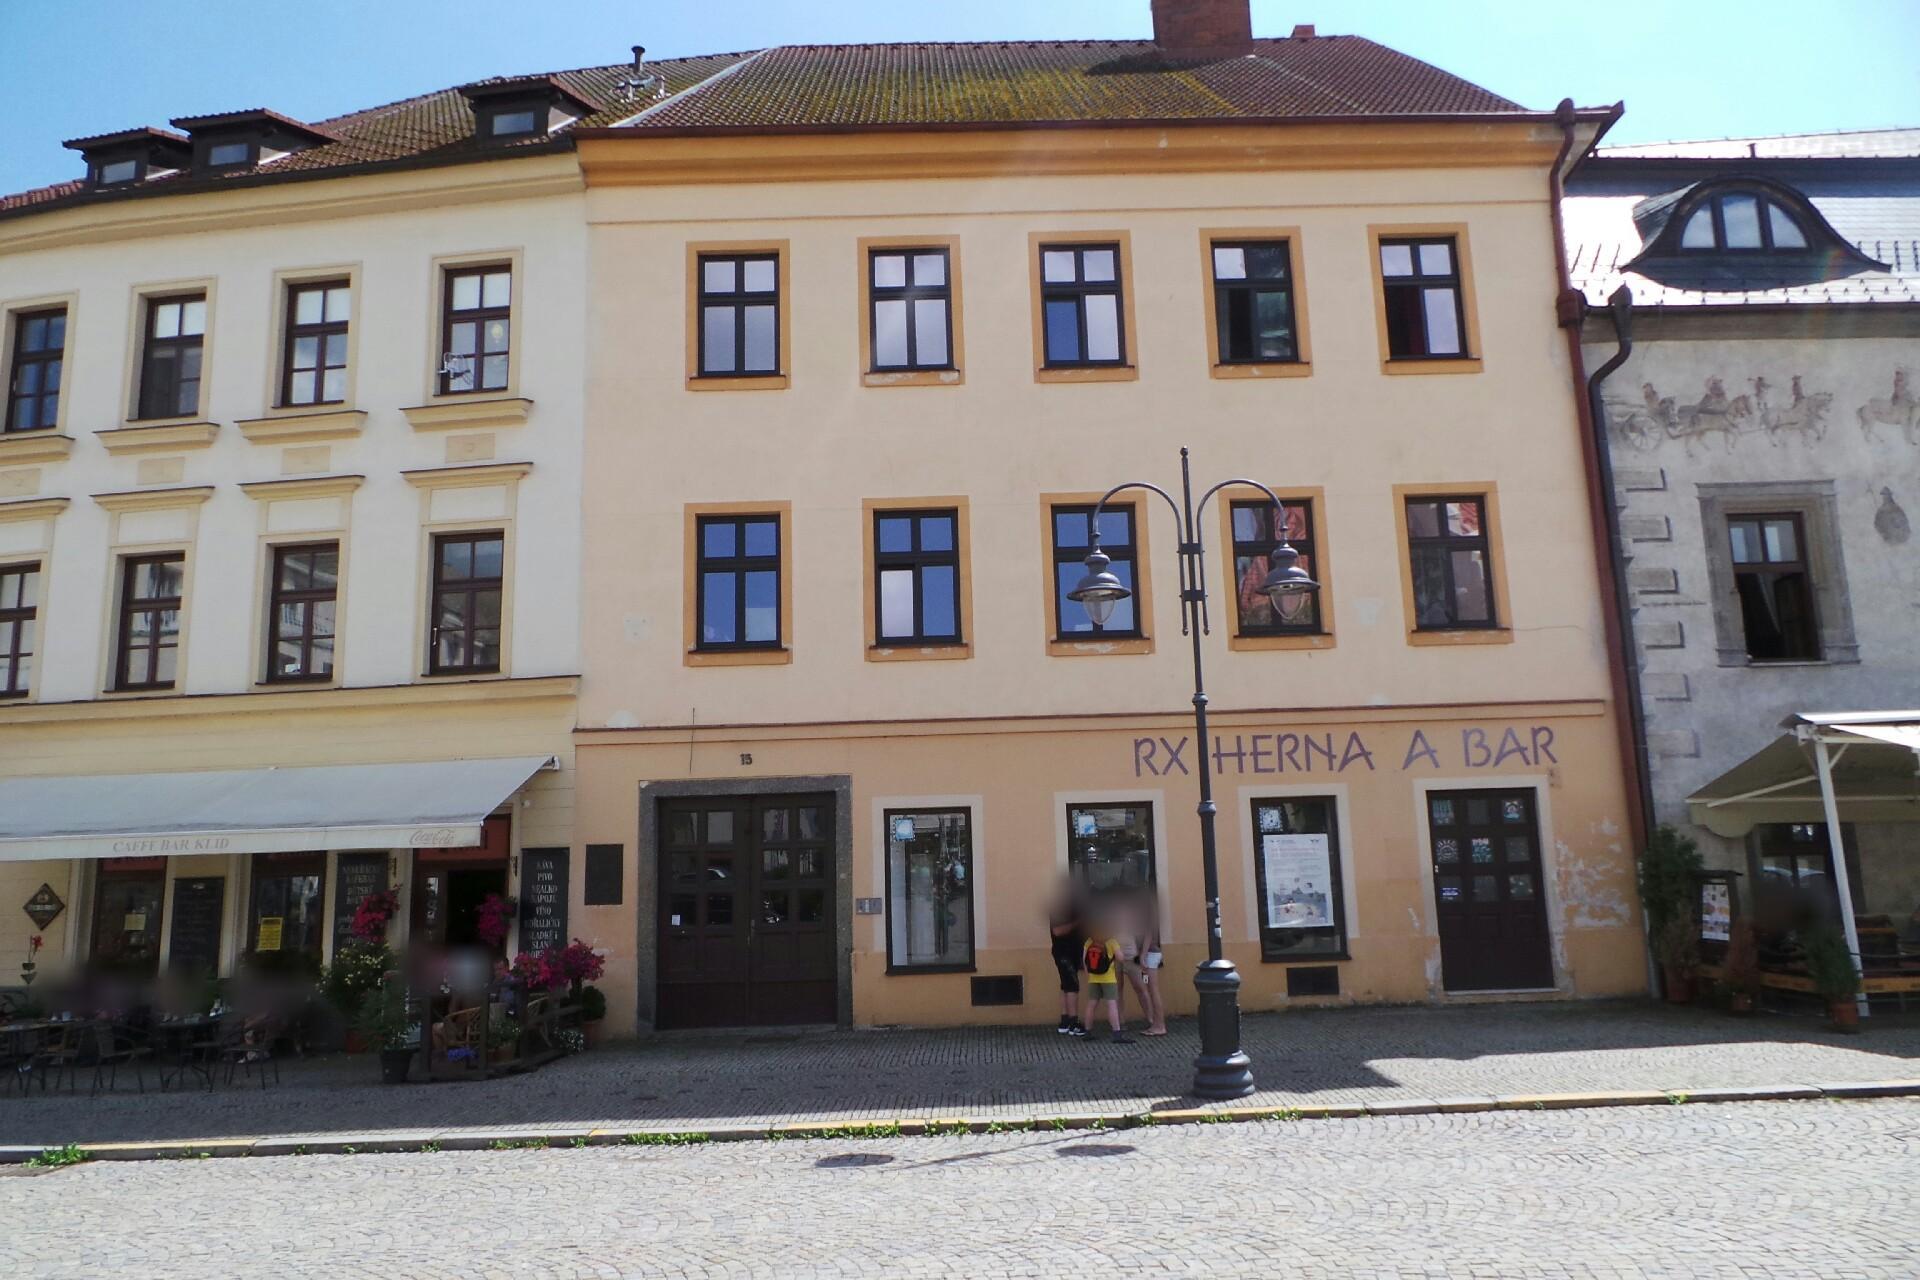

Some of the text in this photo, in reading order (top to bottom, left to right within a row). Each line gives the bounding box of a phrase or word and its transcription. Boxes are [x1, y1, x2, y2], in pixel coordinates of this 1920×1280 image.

[1133, 725, 1558, 777] RX HERNA A BAR
[739, 753, 753, 766] 15
[160, 838, 190, 851] BAR
[193, 837, 230, 850] KLID
